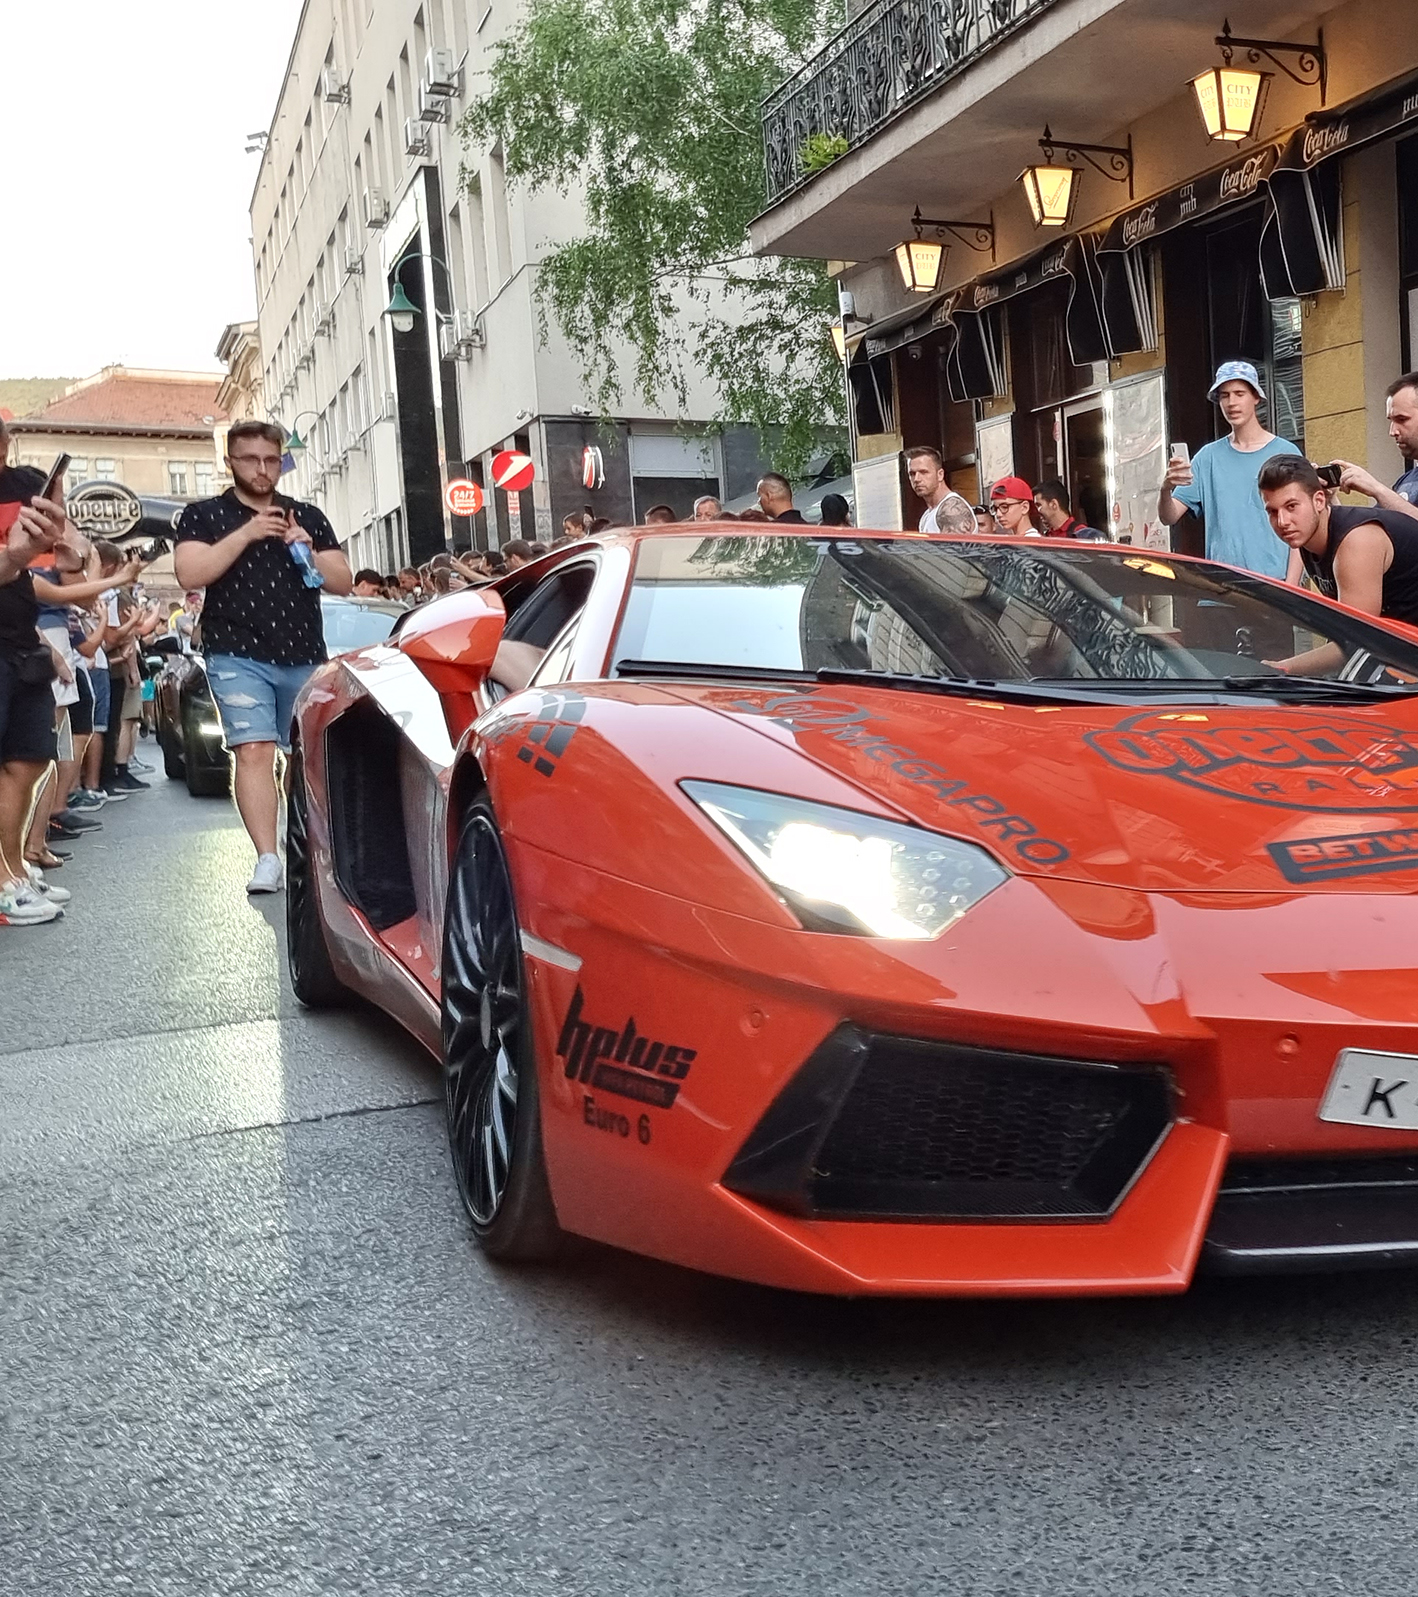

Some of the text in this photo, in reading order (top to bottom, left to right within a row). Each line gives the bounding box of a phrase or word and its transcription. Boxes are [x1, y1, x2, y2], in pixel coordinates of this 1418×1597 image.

[1227, 84, 1253, 95] CITY
[915, 252, 936, 260] CITY
[454, 490, 475, 500] 24/7
[584, 1095, 651, 1145] Euro 6
